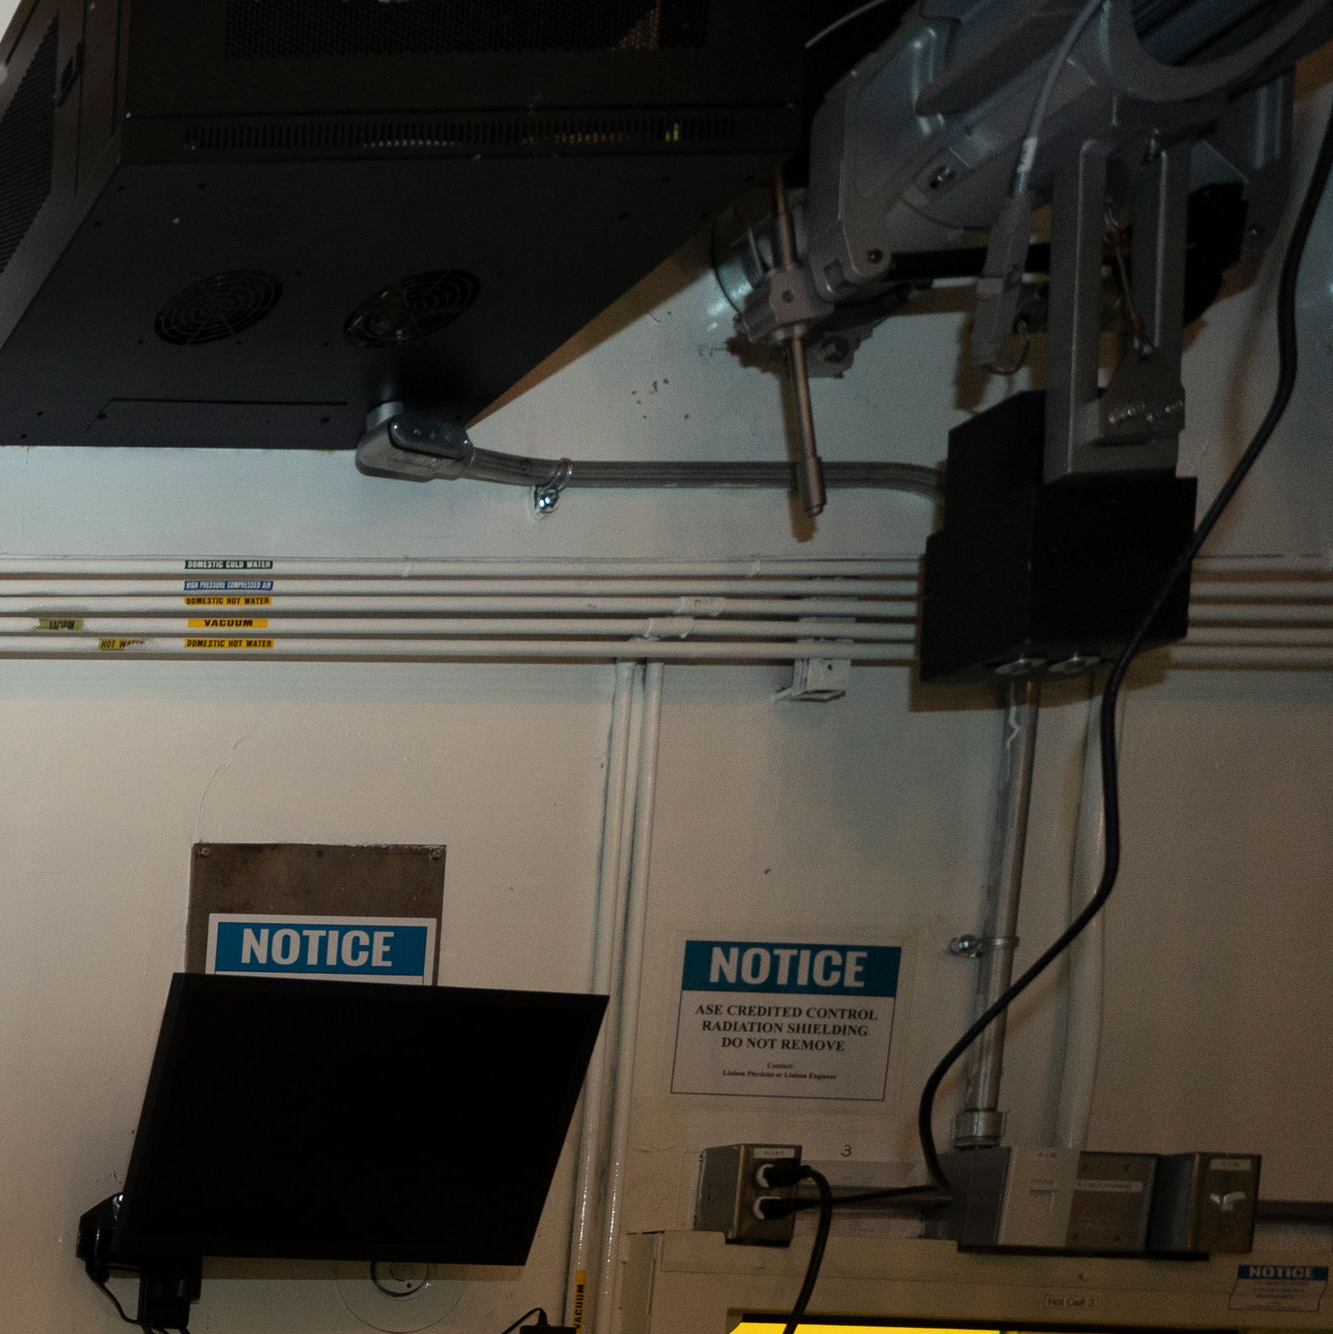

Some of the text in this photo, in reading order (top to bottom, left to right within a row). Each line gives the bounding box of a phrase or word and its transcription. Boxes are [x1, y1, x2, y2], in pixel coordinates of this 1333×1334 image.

[188, 560, 271, 569] DOMESTIC COLD WATER
[186, 597, 270, 605] DOMESTIC HOT WATER
[204, 619, 253, 627] VACUUM
[187, 640, 272, 648] DOMESTIC HOT WATER
[240, 927, 395, 967] NOTICE
[709, 946, 868, 988] NOTICE
[695, 1004, 878, 1021] ASE CREDITED CONTROL
[702, 1021, 869, 1037] RADIATION SHIELDING
[721, 1037, 846, 1051] DO NOT REMOVE
[840, 1144, 852, 1157] 3
[1248, 1266, 1314, 1279] NOTICE
[573, 1284, 585, 1329] VACUUM
[1047, 1297, 1065, 1306] Hot
